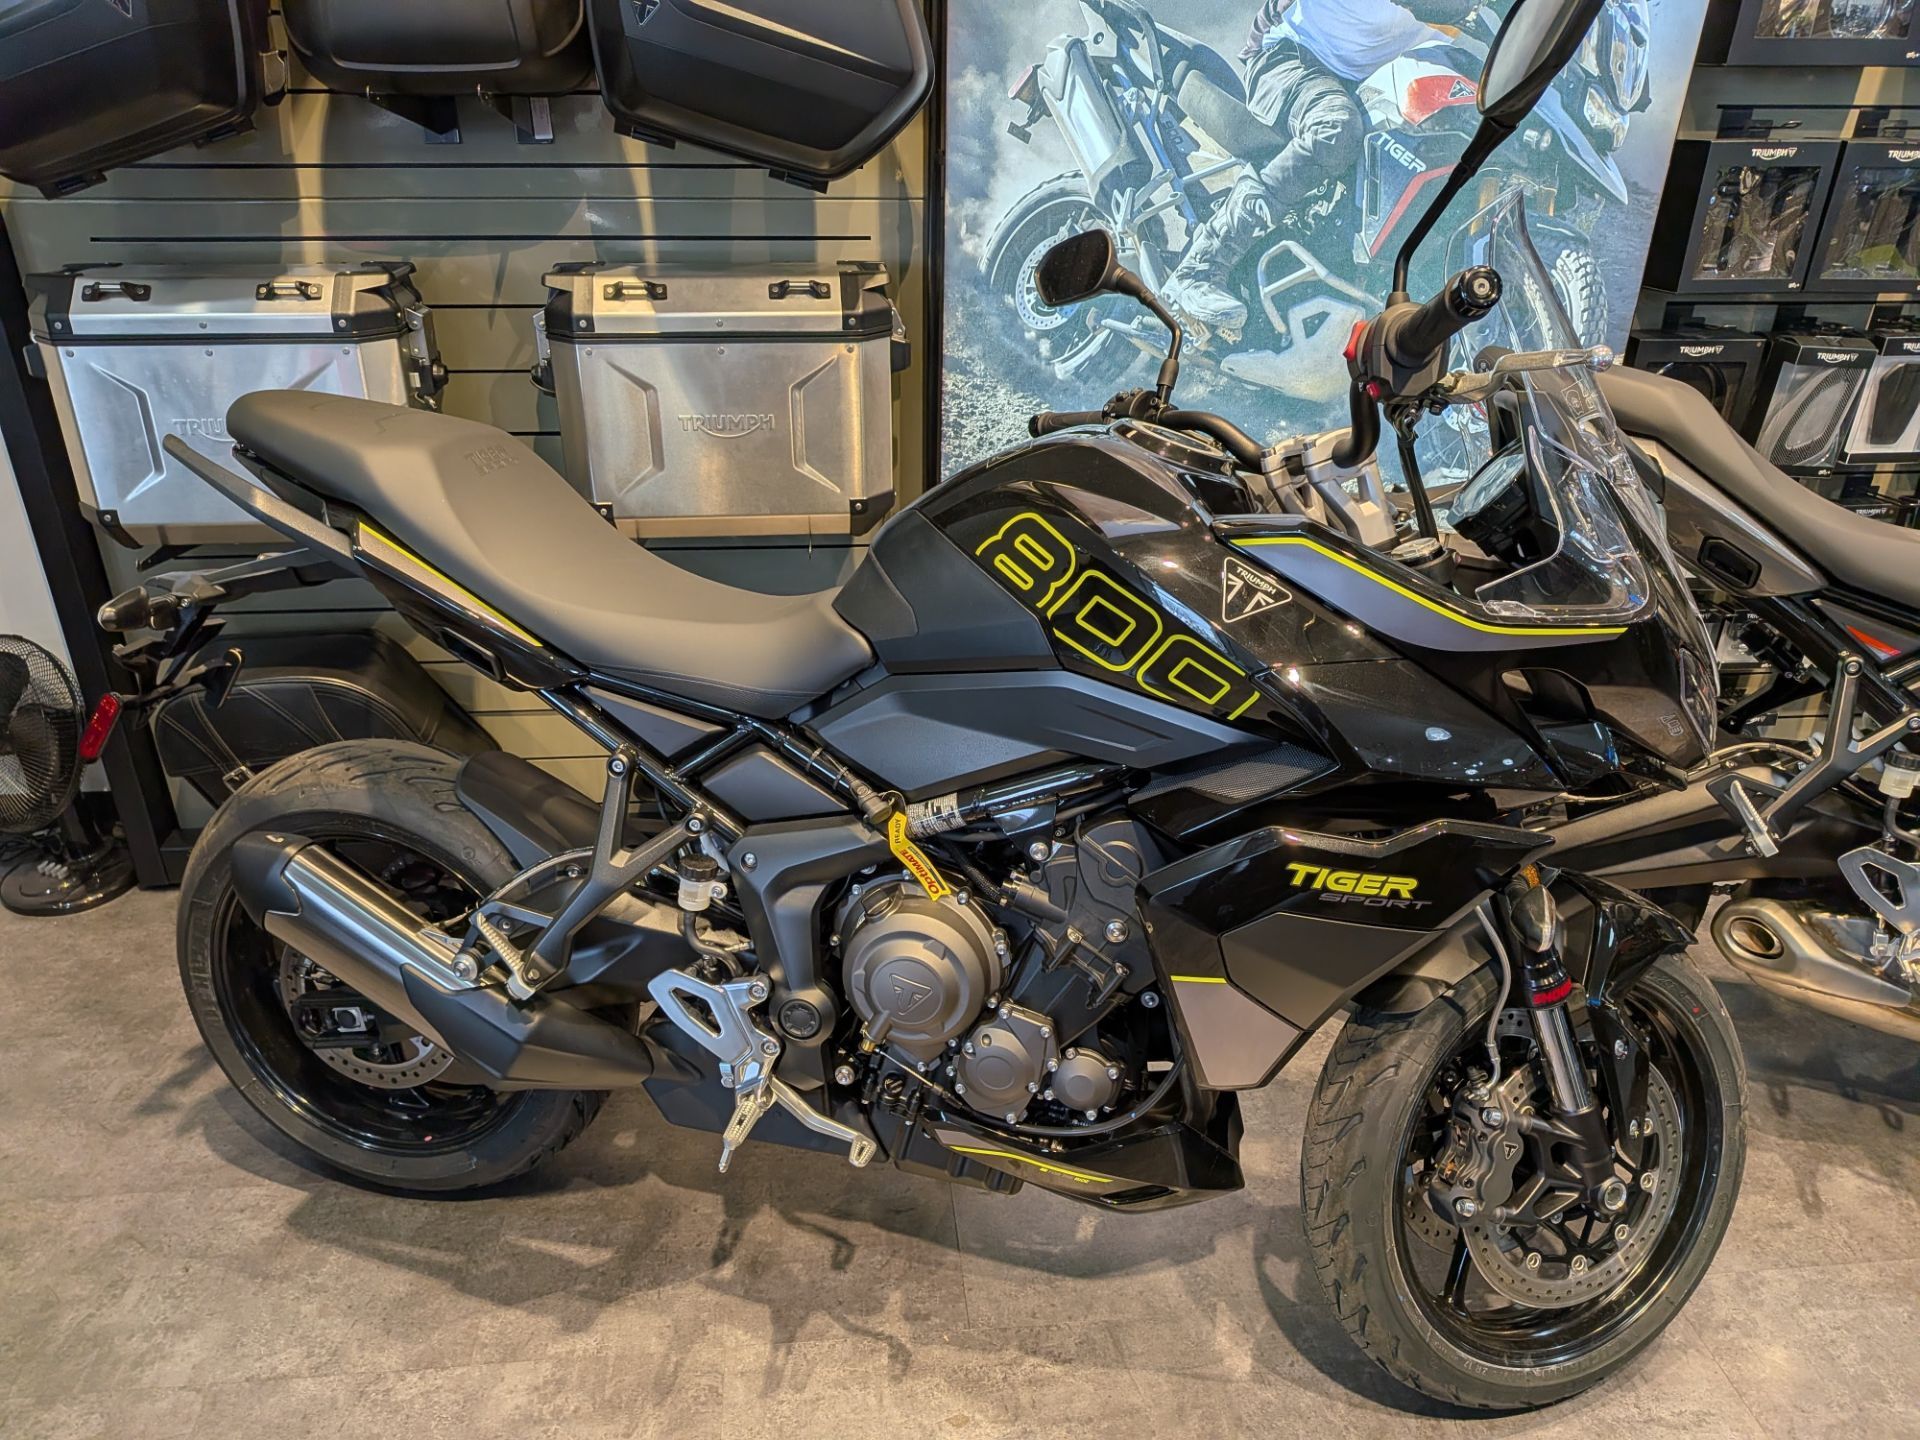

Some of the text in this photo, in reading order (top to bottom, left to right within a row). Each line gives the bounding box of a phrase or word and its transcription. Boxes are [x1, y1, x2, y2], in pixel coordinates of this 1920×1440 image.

[1377, 132, 1427, 172] TIGER
[1752, 148, 1788, 160] TRIUMPH
[1680, 346, 1716, 356] TRIUMPH
[1817, 352, 1850, 363] TRIUMPH
[171, 418, 227, 437] TRIU
[677, 414, 775, 437] TRIUMPH
[1236, 567, 1276, 595] TRIUMPH
[975, 512, 1260, 721] 800
[1286, 863, 1418, 899] TIGER
[1319, 893, 1432, 909] SPORT
